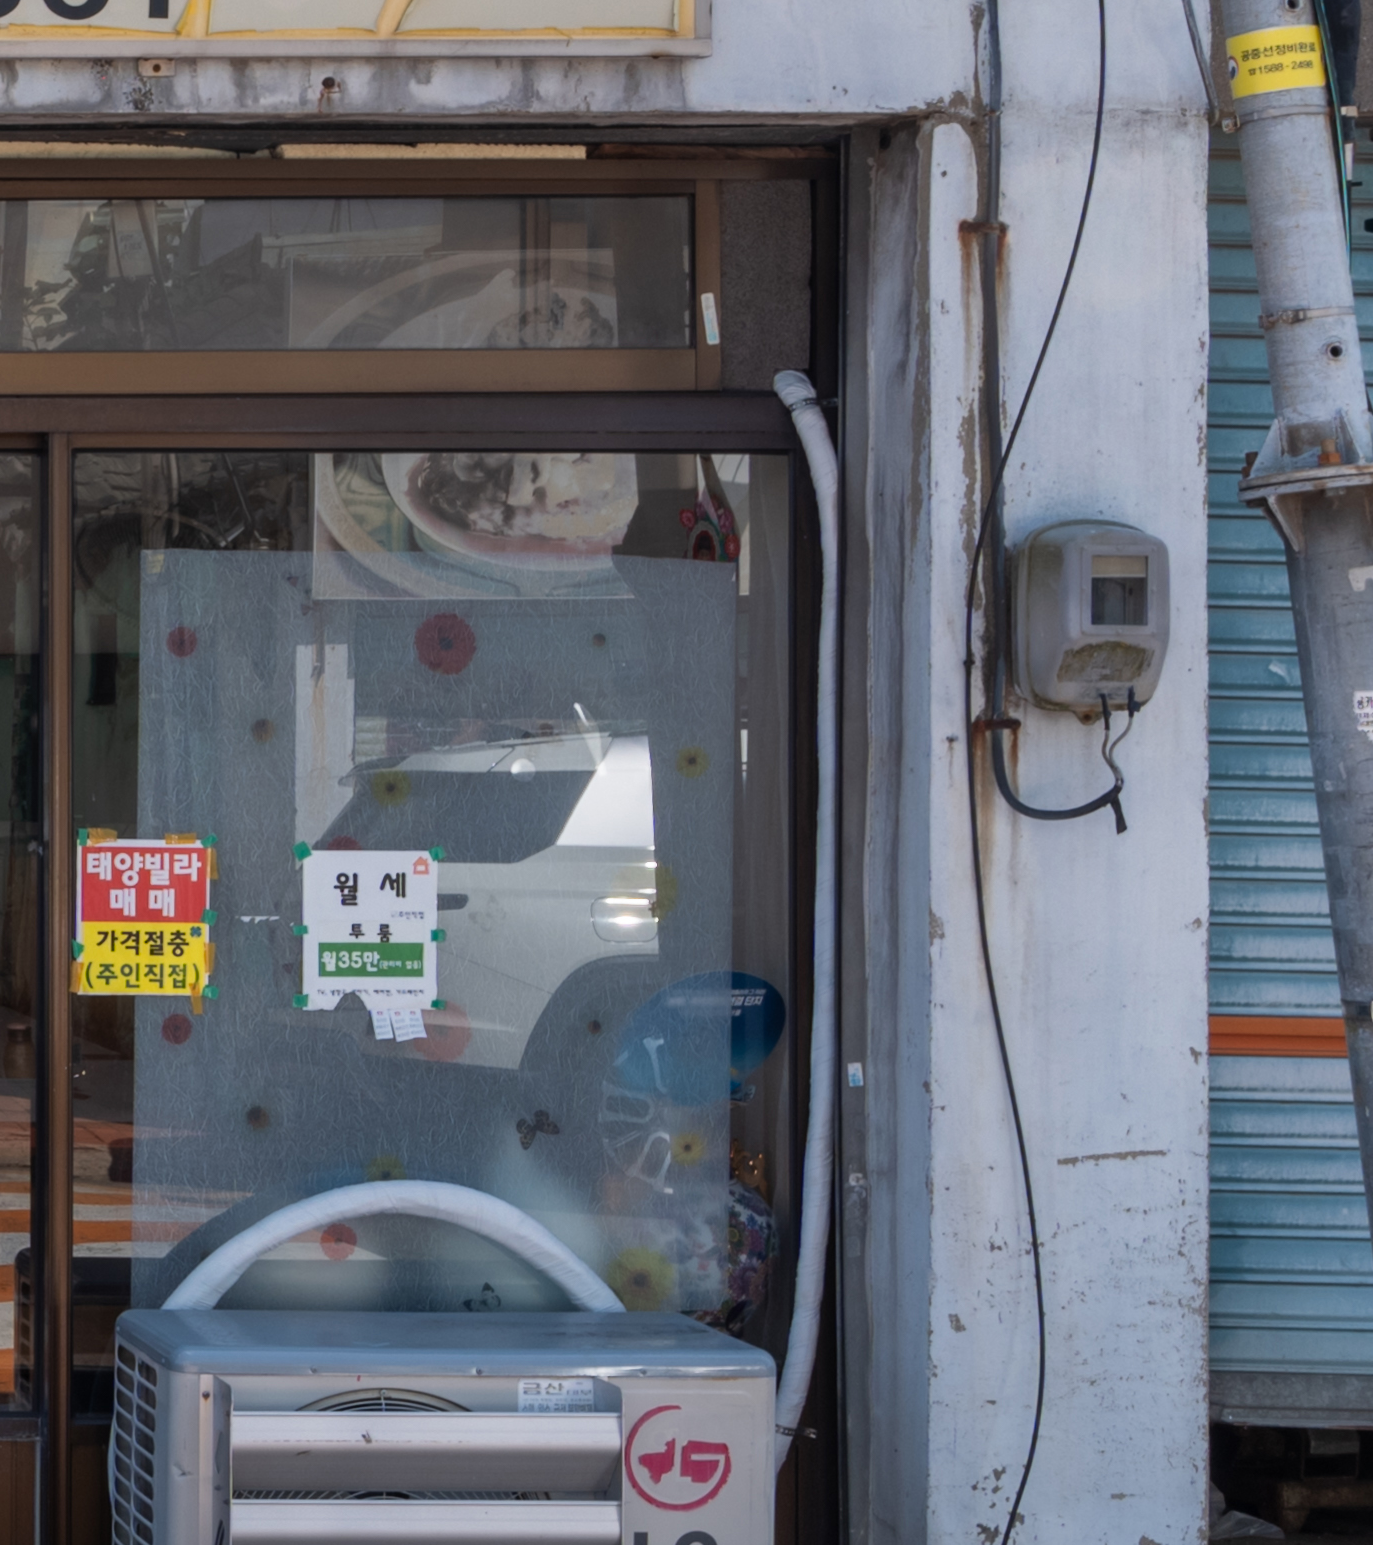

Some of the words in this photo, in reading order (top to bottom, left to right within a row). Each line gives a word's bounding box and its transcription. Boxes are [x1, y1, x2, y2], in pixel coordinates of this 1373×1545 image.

[86, 852, 202, 886] 태양빌라
[96, 930, 189, 957] 가격절충
[321, 951, 380, 972] 월35만
[85, 962, 200, 989] (주인직접)
